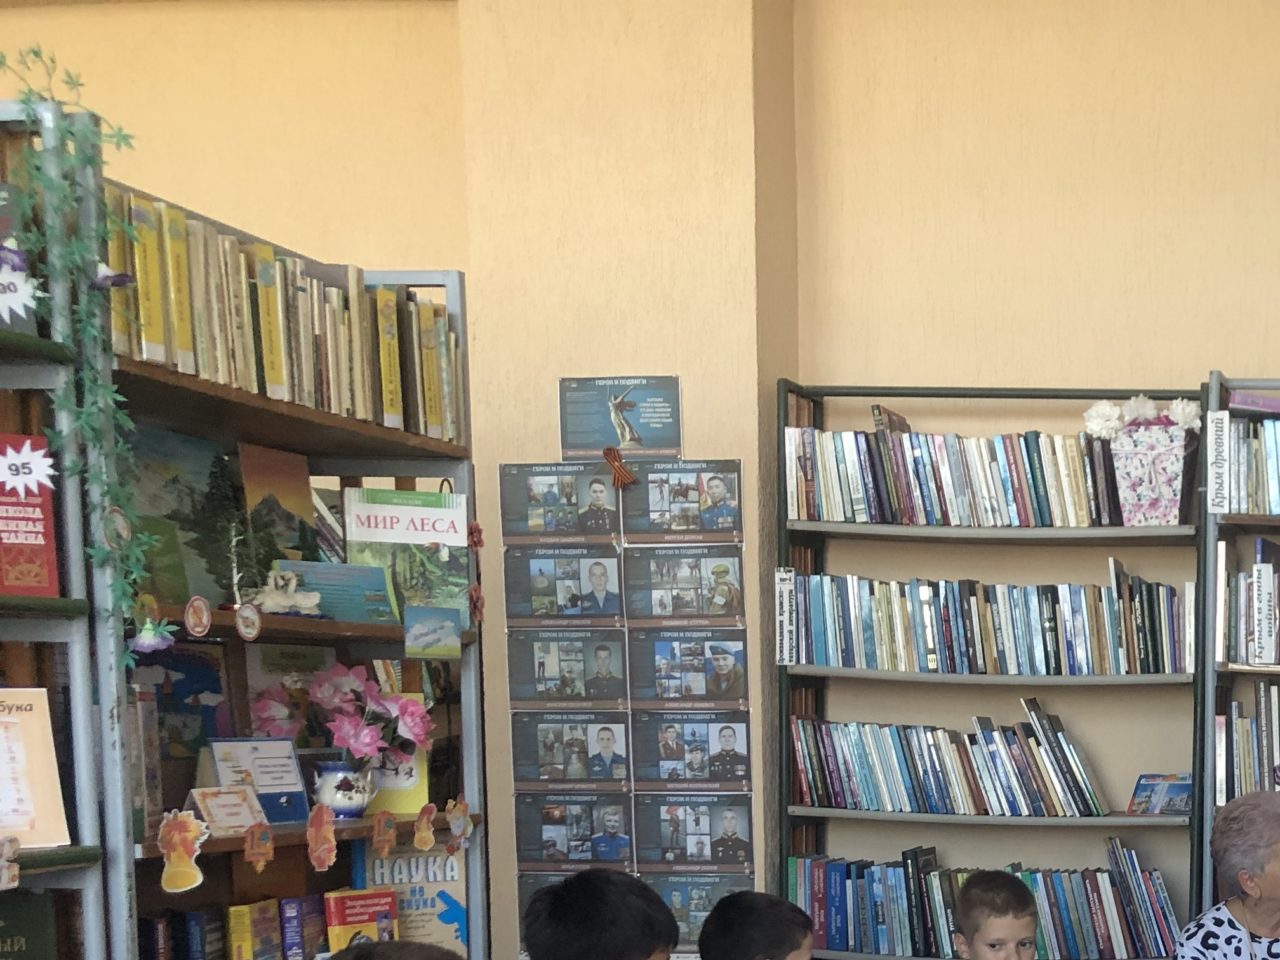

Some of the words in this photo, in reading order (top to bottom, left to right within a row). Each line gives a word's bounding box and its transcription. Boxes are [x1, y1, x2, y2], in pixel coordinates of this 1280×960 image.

[1210, 417, 1228, 468] древний
[8, 462, 33, 476] 95
[1211, 471, 1228, 508] Крым
[355, 514, 400, 531] МИР
[406, 517, 459, 534] ЛЕСА
[373, 855, 459, 885] НАУКА
